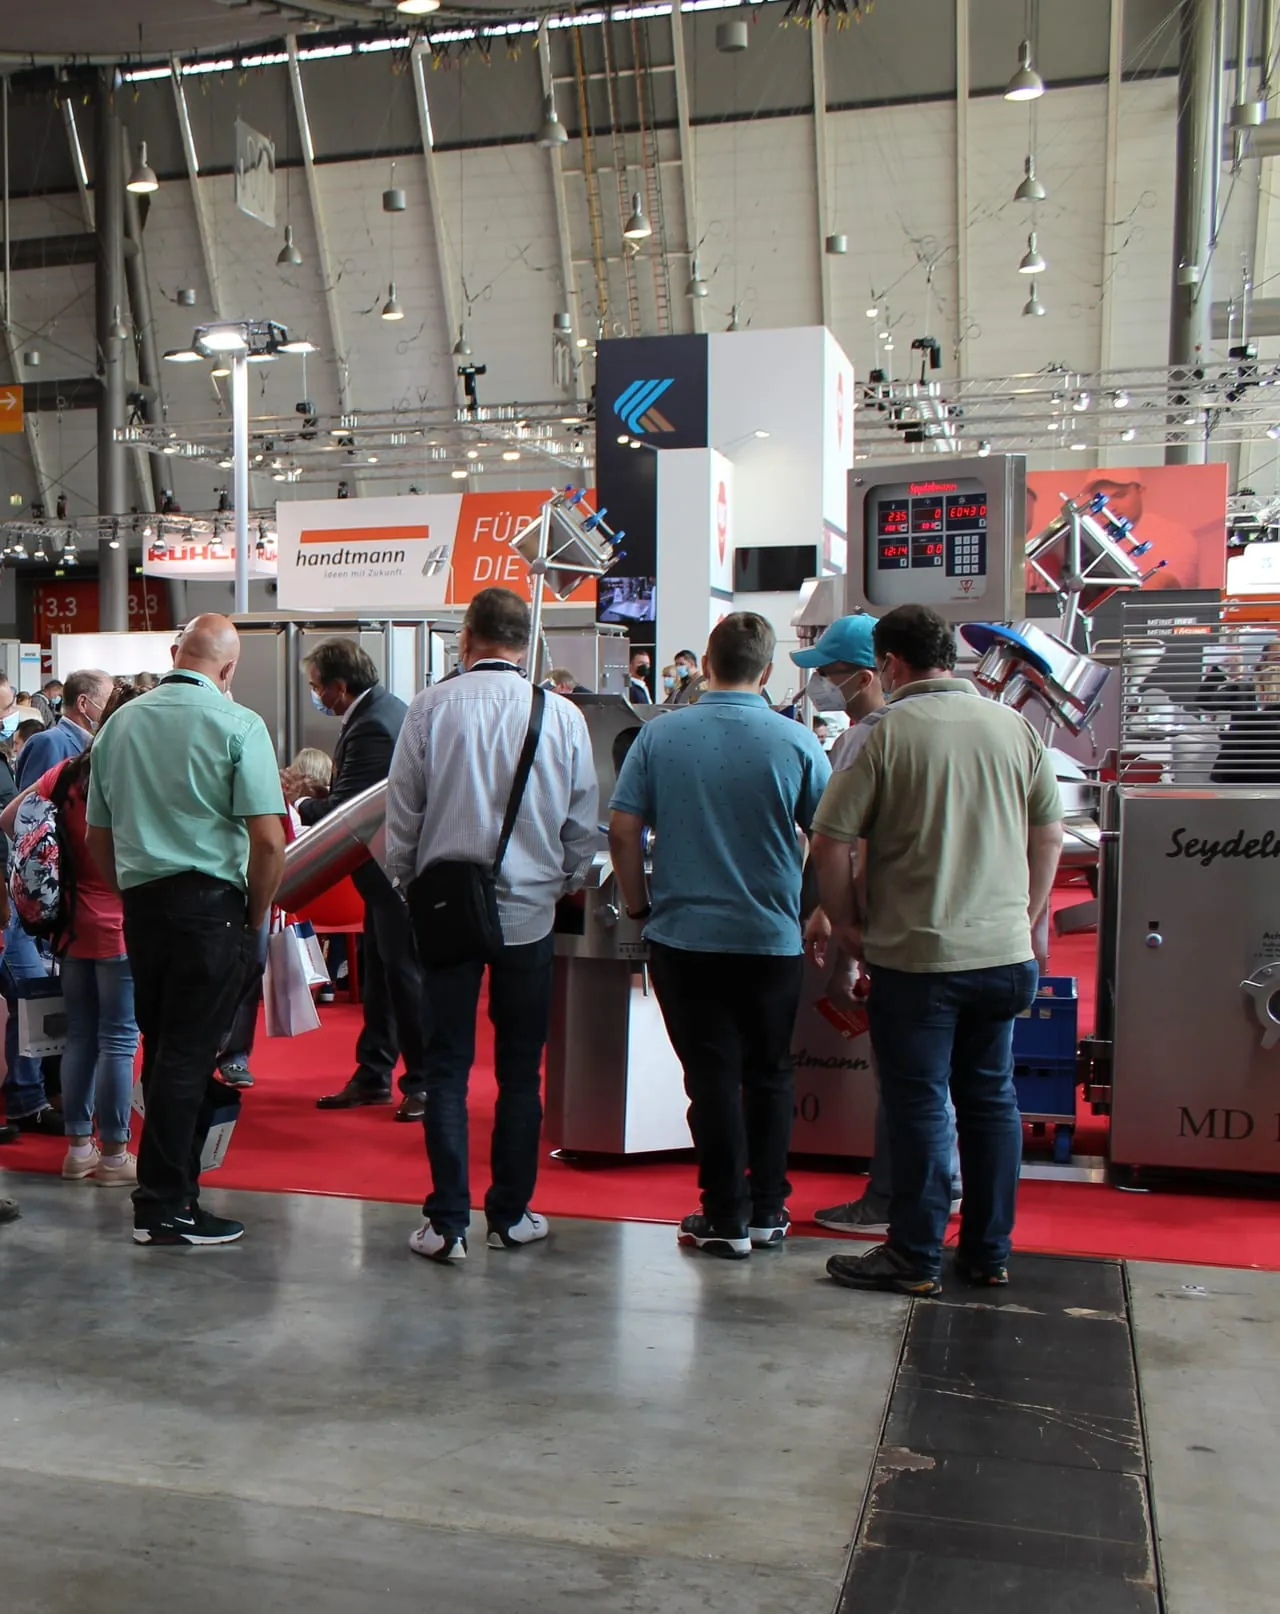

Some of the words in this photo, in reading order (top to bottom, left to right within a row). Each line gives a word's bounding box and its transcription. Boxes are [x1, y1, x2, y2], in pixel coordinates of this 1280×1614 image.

[473, 512, 533, 543] FÜR
[148, 545, 251, 561] RÜHL
[296, 549, 405, 567] handtmann
[473, 555, 521, 582] DIE
[46, 597, 77, 617] 3.3
[128, 594, 159, 615] 3.3
[1165, 827, 1280, 867] Seydel
[1177, 1106, 1255, 1140] MD
